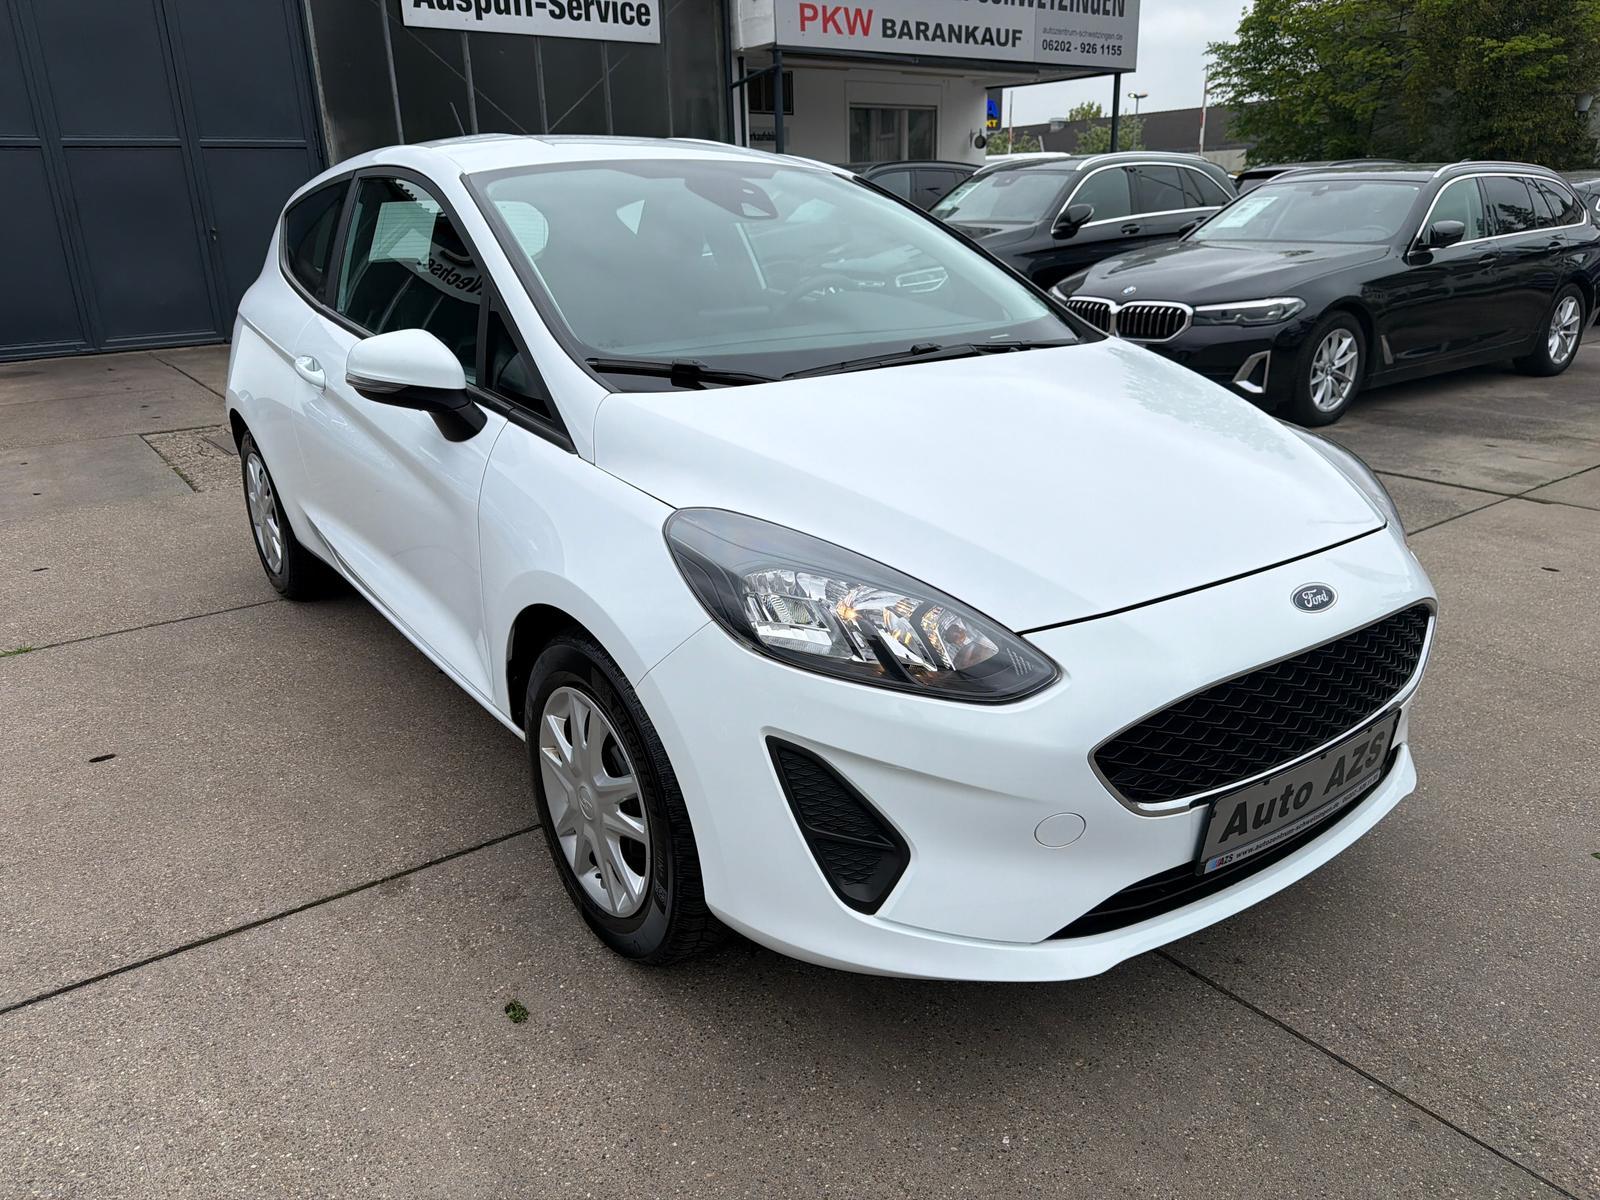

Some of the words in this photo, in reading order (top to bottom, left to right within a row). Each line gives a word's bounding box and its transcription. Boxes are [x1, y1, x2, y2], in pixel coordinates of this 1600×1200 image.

[413, 0, 652, 26] spuff-Service
[799, 3, 873, 37] PKW
[881, 18, 1023, 48] BARANKAUF
[1042, 39, 1072, 53] 06202
[1080, 42, 1097, 54] 926
[1100, 45, 1122, 56] 1155
[1302, 589, 1329, 607] Ford
[1218, 781, 1313, 844] Auto
[1323, 732, 1385, 795] AZS
